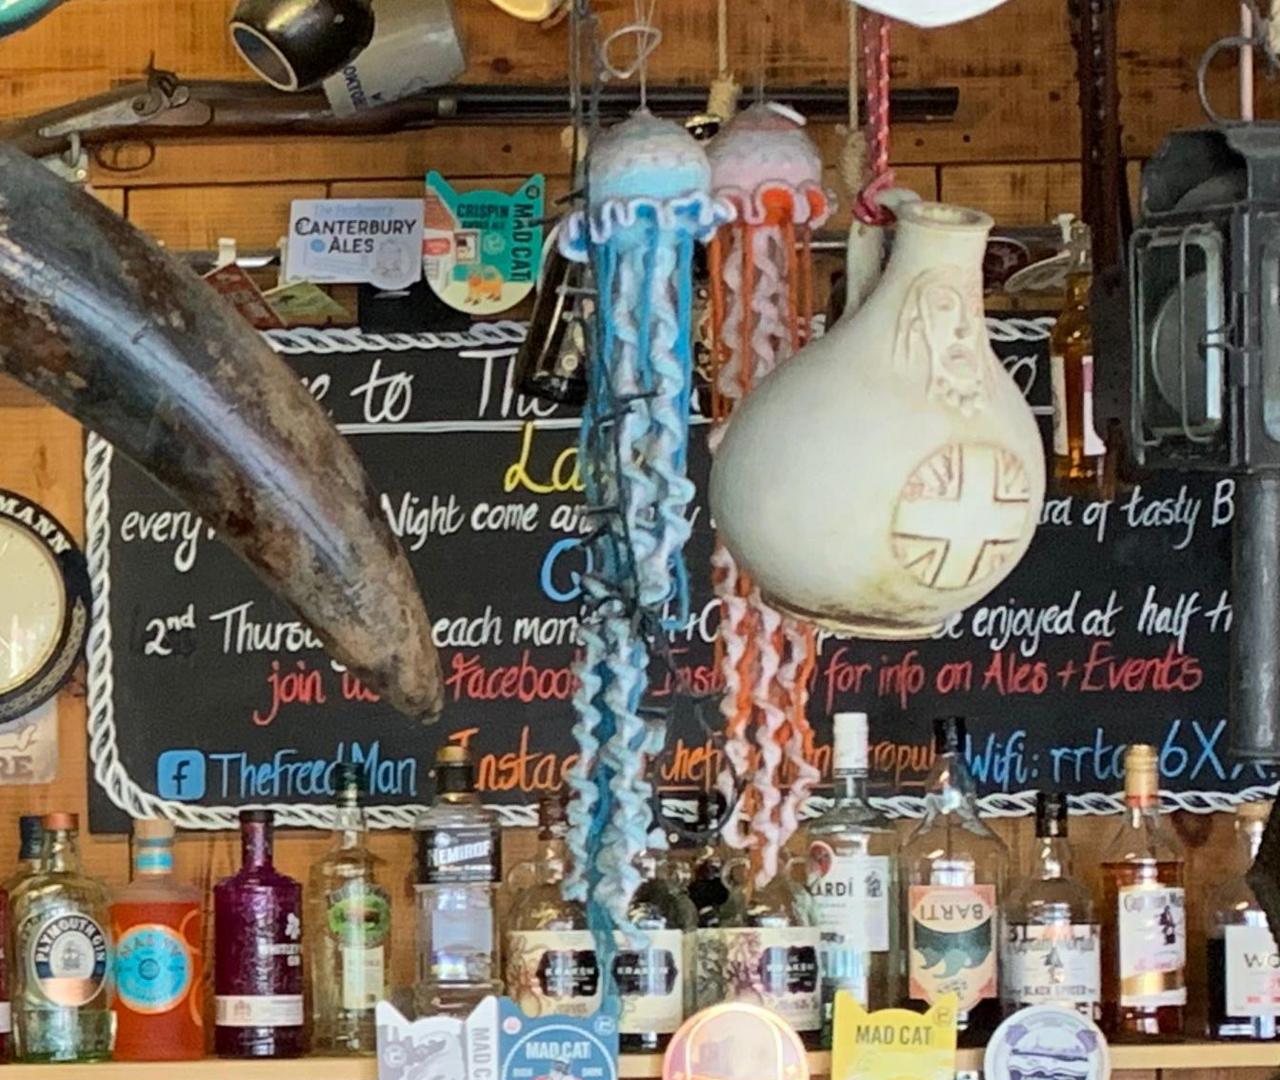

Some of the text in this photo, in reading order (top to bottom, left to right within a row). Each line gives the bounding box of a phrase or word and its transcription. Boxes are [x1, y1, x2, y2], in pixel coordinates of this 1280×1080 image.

[295, 216, 418, 237] CANTERBURY
[456, 203, 510, 219] CRISPIN
[328, 238, 375, 255] ALES
[511, 247, 533, 282] CAT
[350, 359, 415, 424] to
[121, 514, 203, 573] every
[470, 500, 538, 534] come
[1121, 485, 1202, 549] tasty
[144, 603, 195, 657] 2nd
[432, 608, 503, 648] each
[972, 590, 1081, 657] enjoyed
[1081, 590, 1123, 638] at
[1138, 585, 1199, 654] half
[252, 660, 326, 726] join
[826, 647, 872, 714] for
[878, 647, 925, 711] info
[937, 660, 972, 694] on
[982, 652, 1049, 696] Ales
[1080, 640, 1203, 693] Events
[920, 903, 984, 921] BARTI
[35, 915, 107, 963] PLYMOUTH GIN
[471, 1027, 492, 1071] MAD
[526, 1041, 592, 1060] MAD CAT
[855, 1025, 933, 1045] MAD CAT
